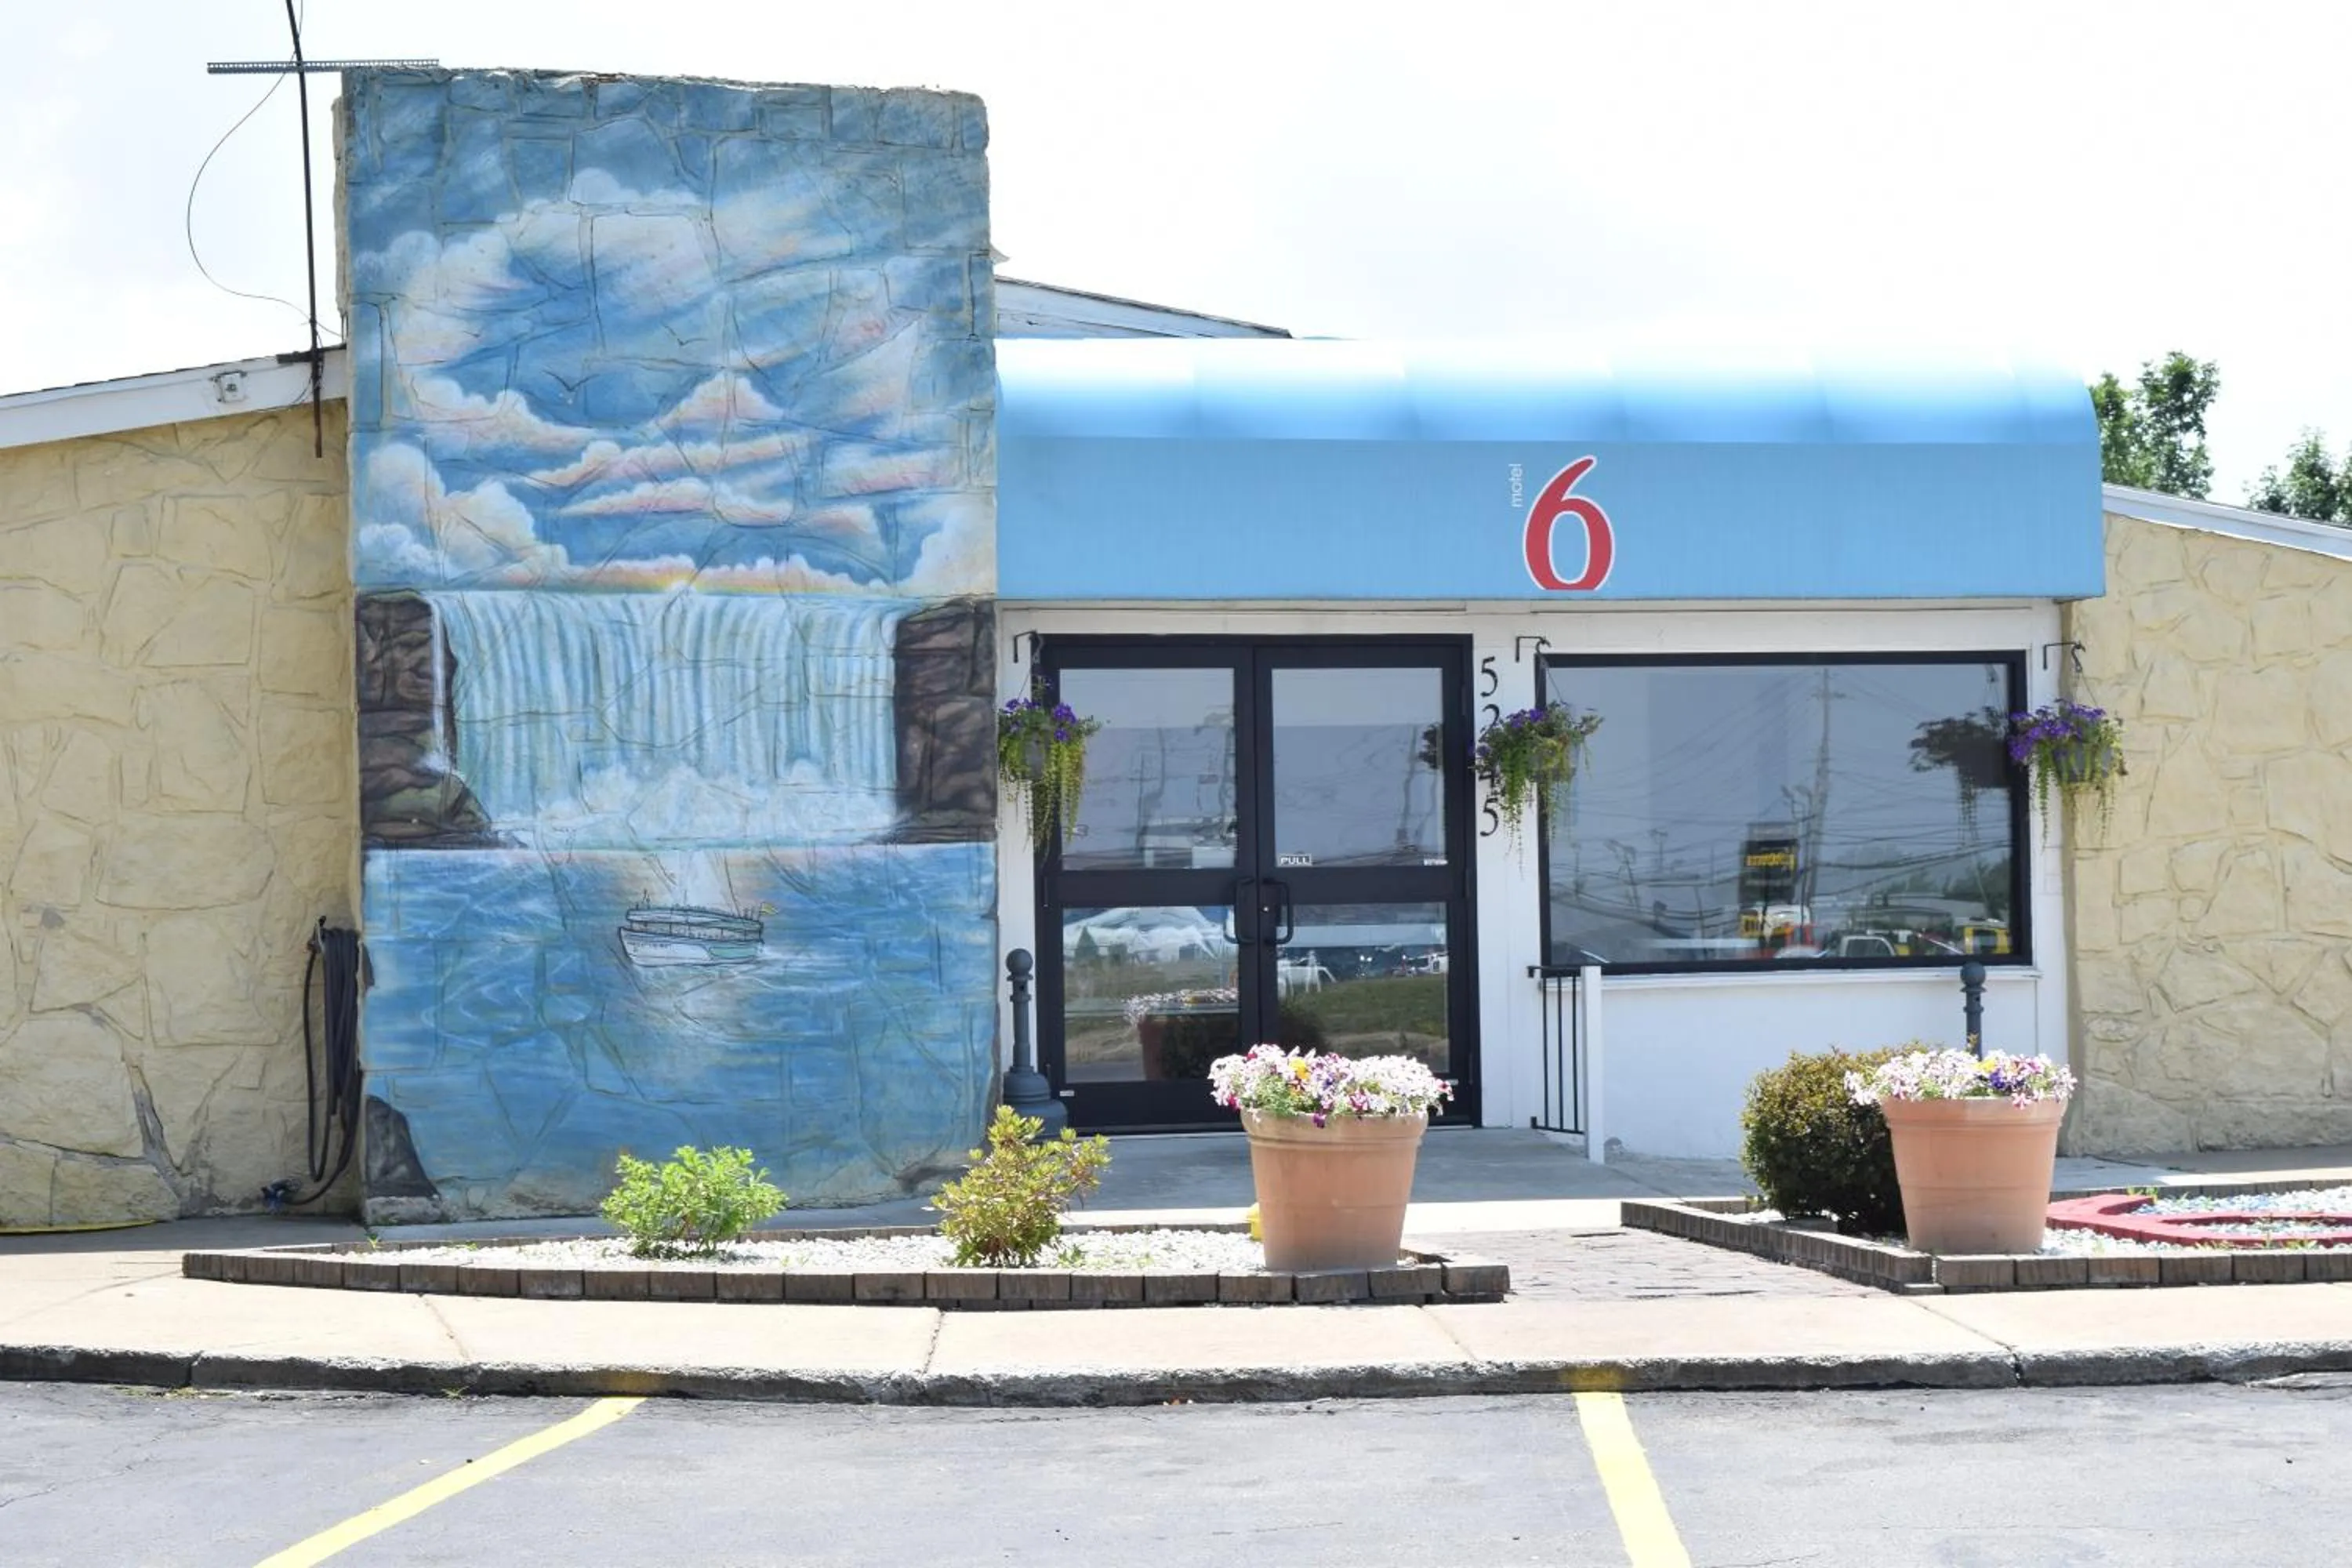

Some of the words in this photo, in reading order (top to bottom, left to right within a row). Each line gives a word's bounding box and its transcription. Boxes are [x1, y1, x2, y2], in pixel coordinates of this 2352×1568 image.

[1508, 463, 1523, 508] motel
[1522, 454, 1615, 590] 6
[1279, 856, 1311, 866] PULL
